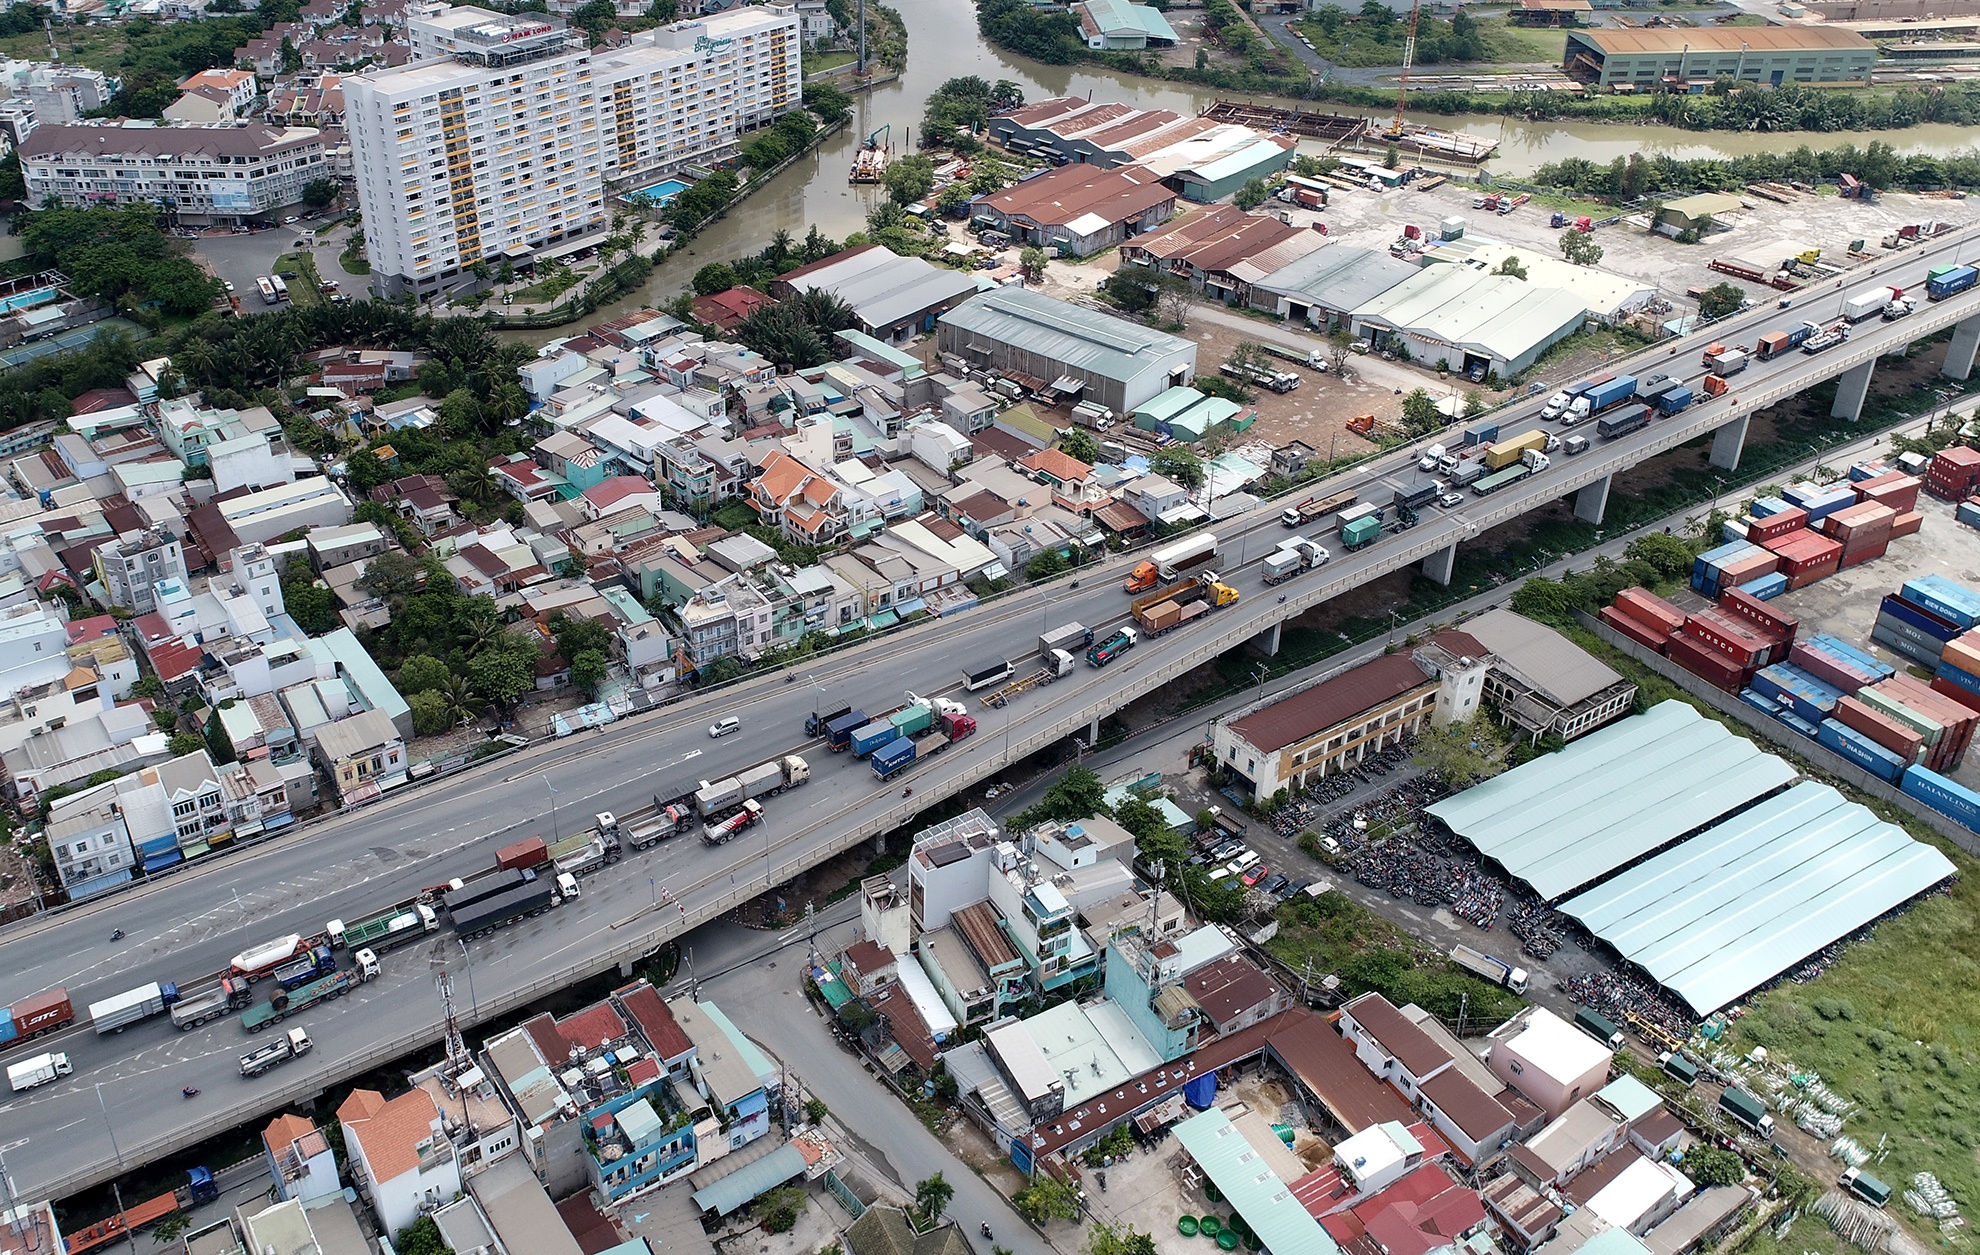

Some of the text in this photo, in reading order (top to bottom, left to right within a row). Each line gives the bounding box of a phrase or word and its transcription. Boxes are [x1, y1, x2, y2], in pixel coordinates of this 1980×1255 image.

[512, 26, 551, 39] NAM LONG
[1736, 603, 1771, 626] VOSCO
[1925, 599, 1957, 619] BIEN DONG
[1699, 630, 1734, 653] VOSCO
[1905, 627, 1922, 641] MOL
[1900, 641, 1917, 655] MOL
[1776, 693, 1795, 709] APL
[714, 794, 738, 806] MAERSK
